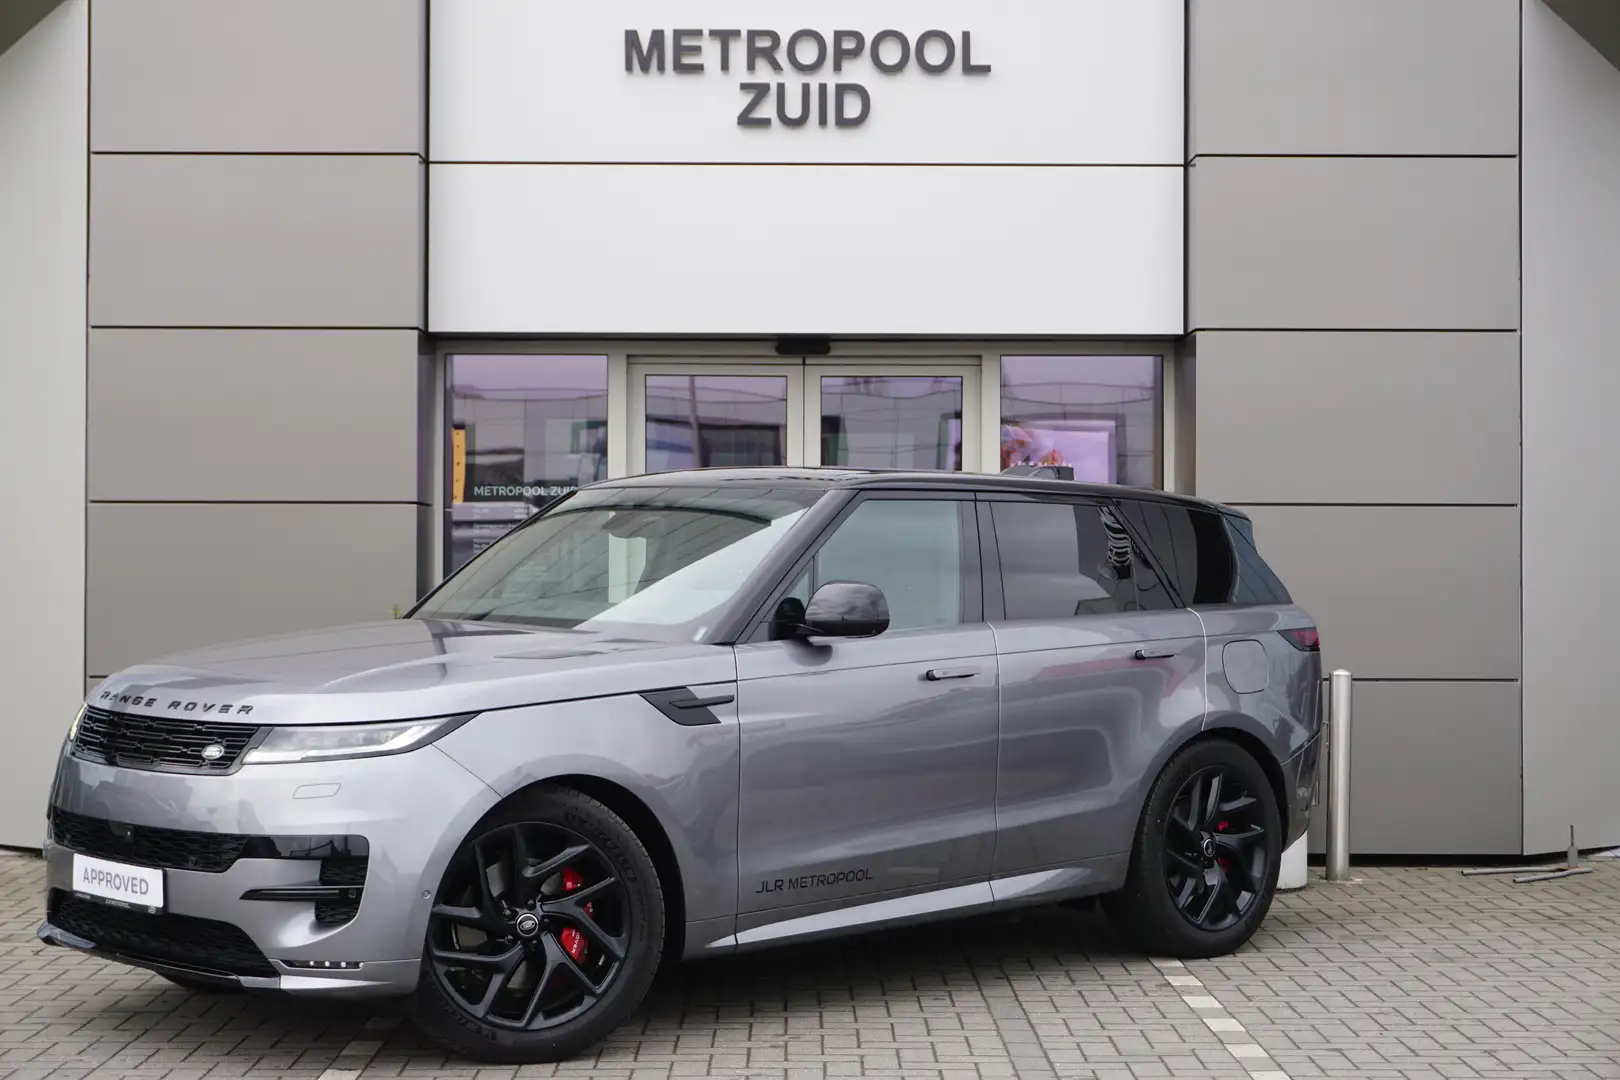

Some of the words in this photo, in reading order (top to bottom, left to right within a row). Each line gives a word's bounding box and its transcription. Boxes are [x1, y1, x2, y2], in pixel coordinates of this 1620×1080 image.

[624, 29, 992, 74] METROPOOL
[737, 82, 871, 127] ZUID
[473, 485, 549, 497] METROPOOL
[100, 690, 158, 708] RANGE
[167, 699, 254, 716] ROVER
[82, 867, 150, 895] APPROVED
[755, 879, 785, 894] JLR
[787, 868, 875, 891] METROPOOL
